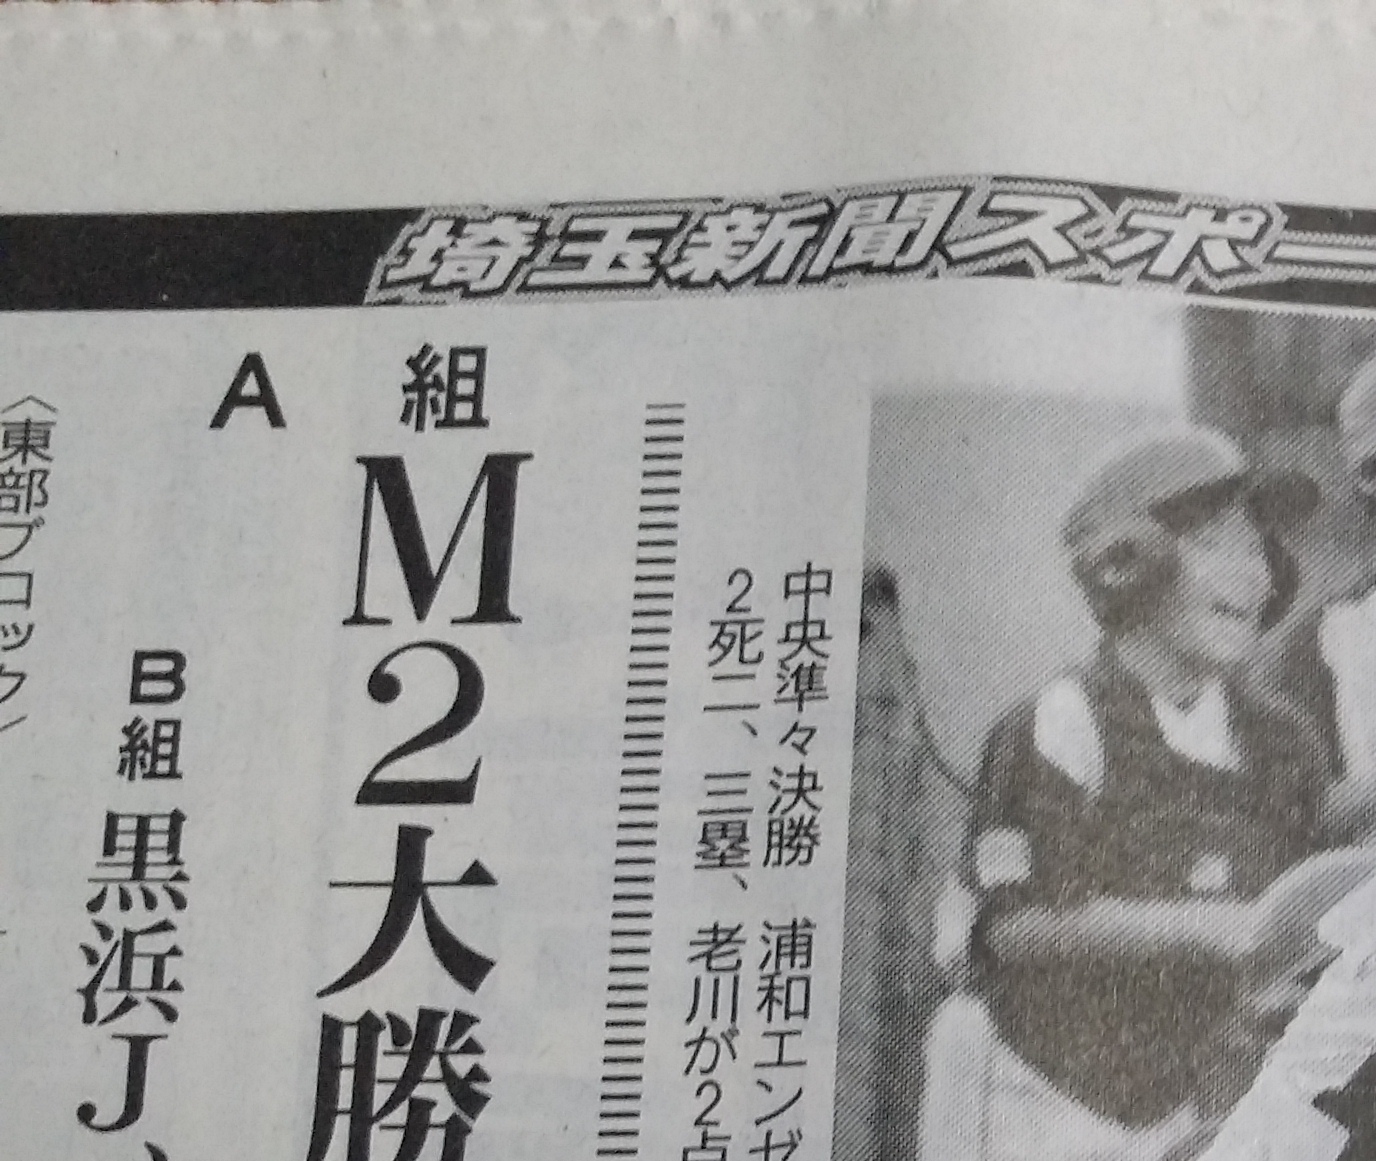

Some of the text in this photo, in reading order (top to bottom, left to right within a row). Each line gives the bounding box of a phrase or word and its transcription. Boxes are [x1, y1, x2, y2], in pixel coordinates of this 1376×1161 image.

[209, 350, 288, 431] A
[762, 560, 834, 869] 中央準々決勝
